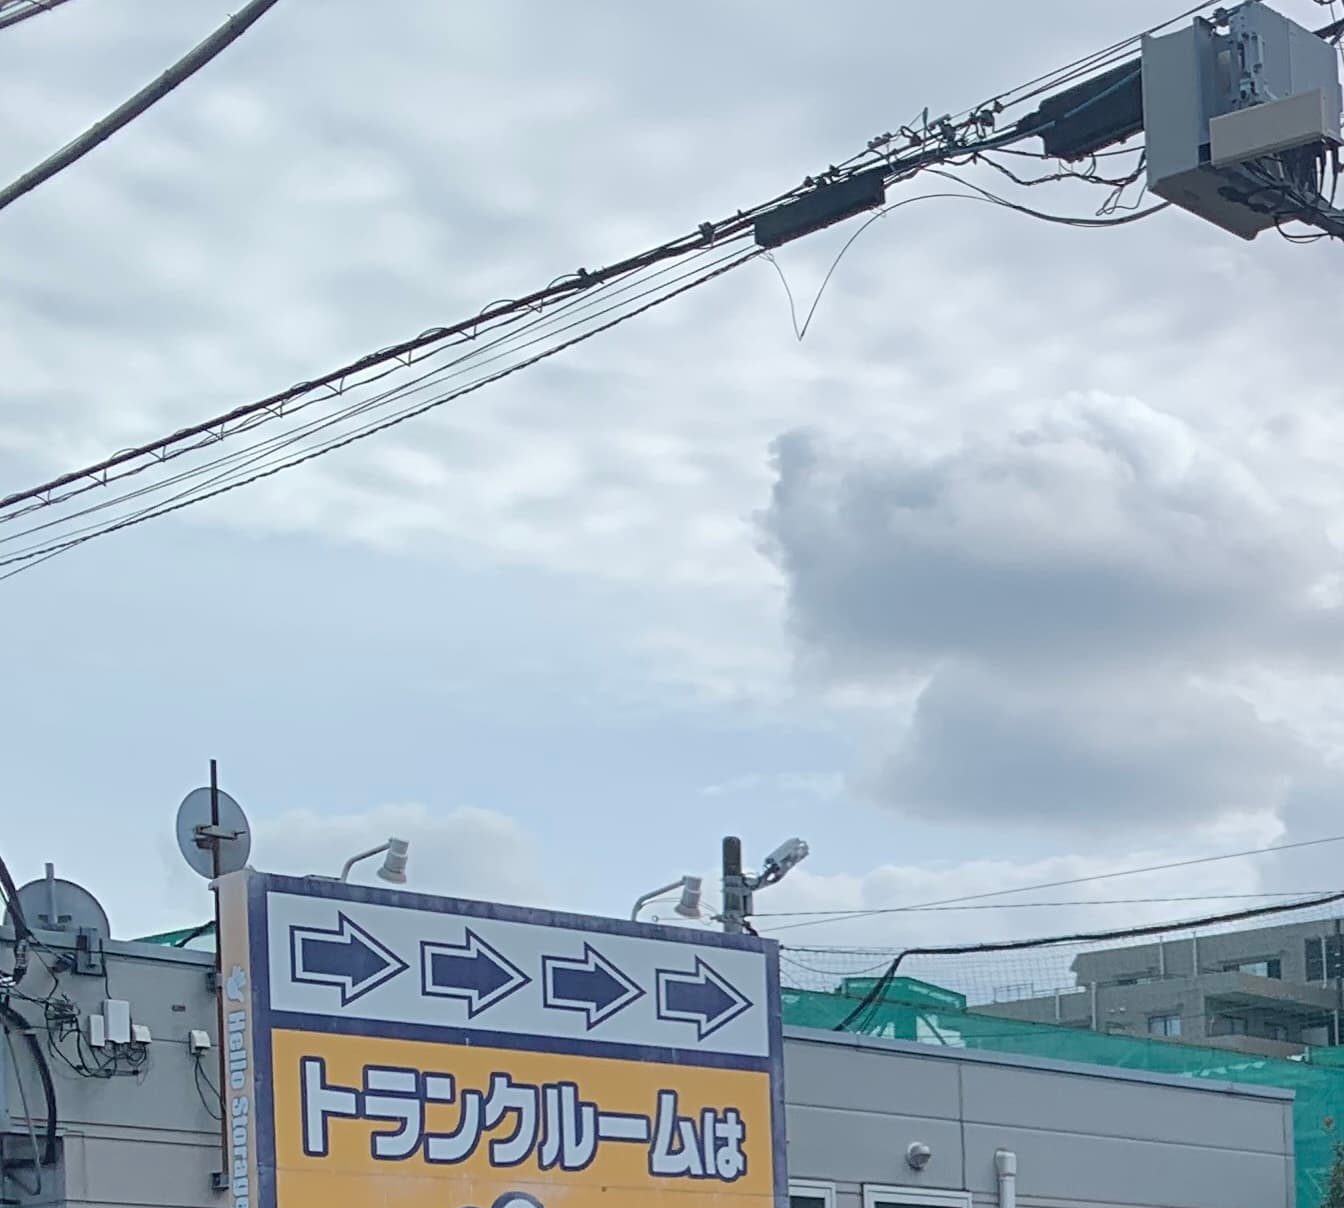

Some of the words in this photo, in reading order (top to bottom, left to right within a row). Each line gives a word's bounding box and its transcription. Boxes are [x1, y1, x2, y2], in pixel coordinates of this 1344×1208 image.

[227, 1009, 248, 1089] Hello
[300, 1056, 747, 1182] トランクルームは
